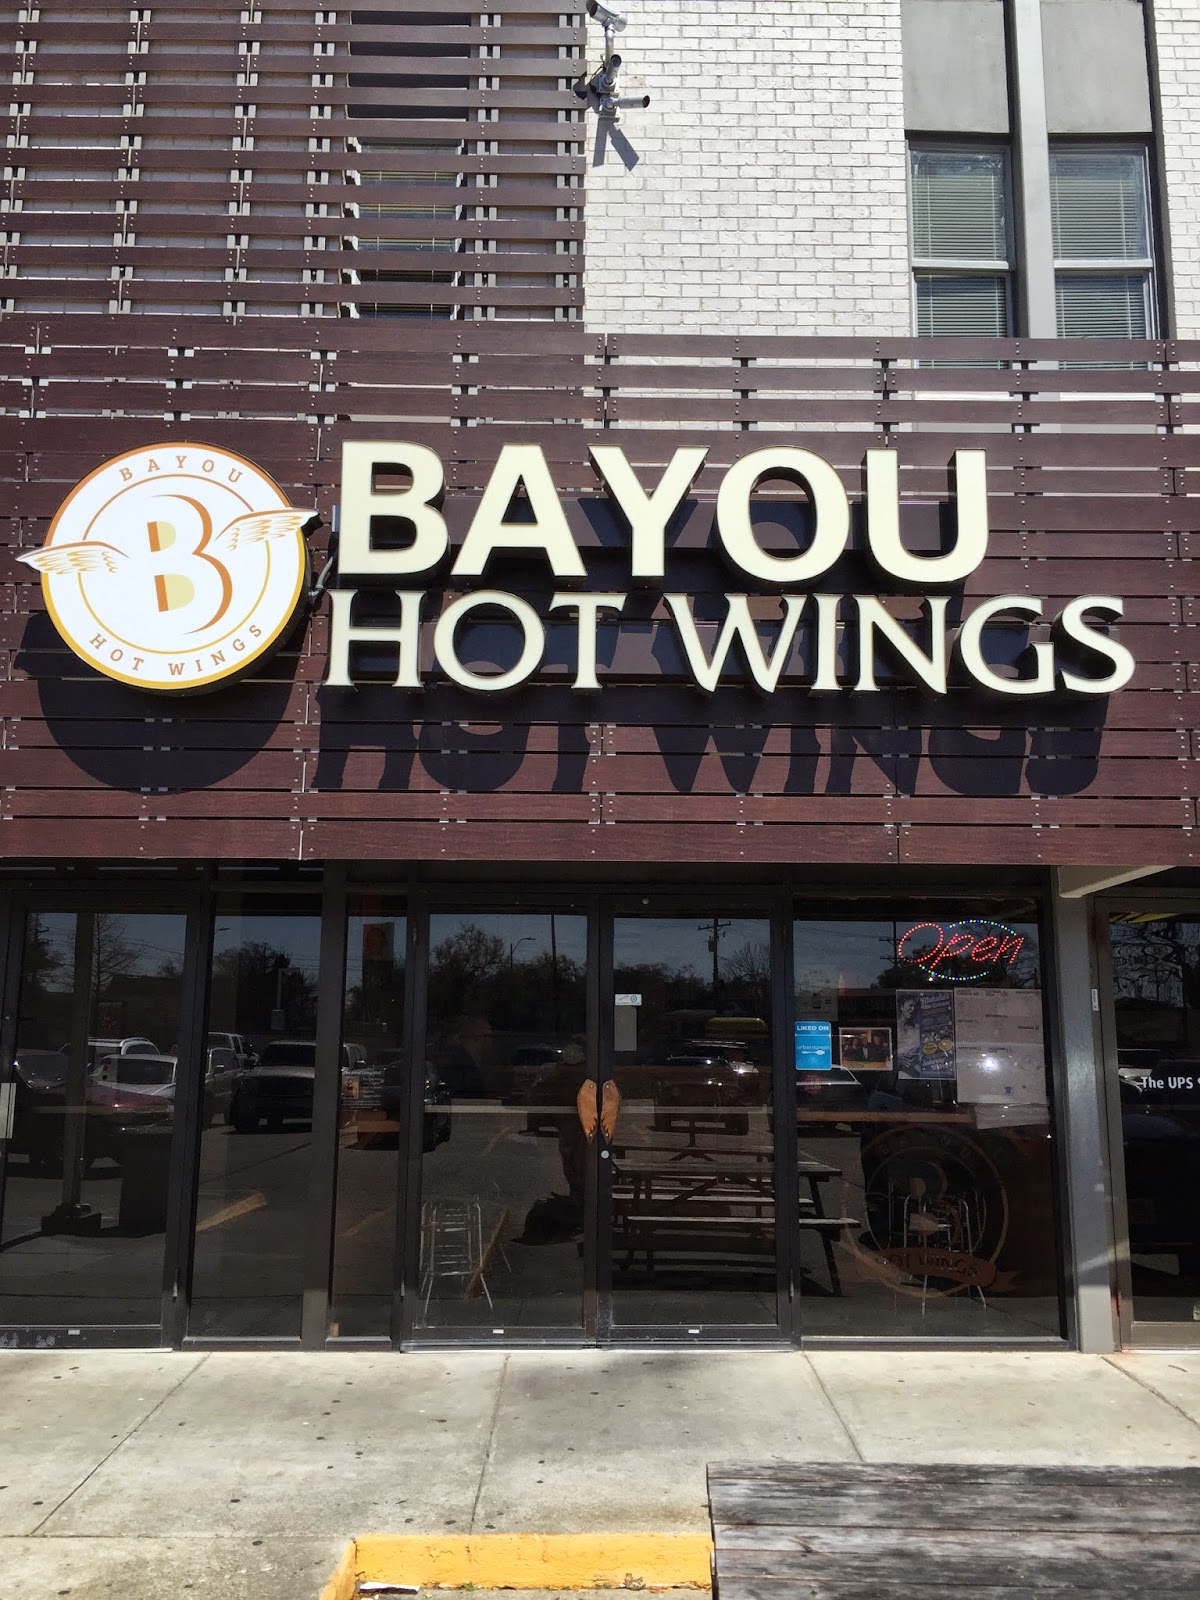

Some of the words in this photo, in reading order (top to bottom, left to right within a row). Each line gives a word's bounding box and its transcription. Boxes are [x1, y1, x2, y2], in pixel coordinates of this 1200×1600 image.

[120, 456, 243, 483] BAYOU
[337, 440, 989, 584] BAYOU
[147, 494, 233, 635] B
[90, 633, 144, 671] HOT
[168, 624, 262, 676] WINGS
[324, 588, 627, 692] HOT
[663, 594, 1136, 695] WINGS
[898, 923, 1025, 969] Open
[1141, 1076, 1164, 1089] The
[1168, 1076, 1194, 1089] UPS
